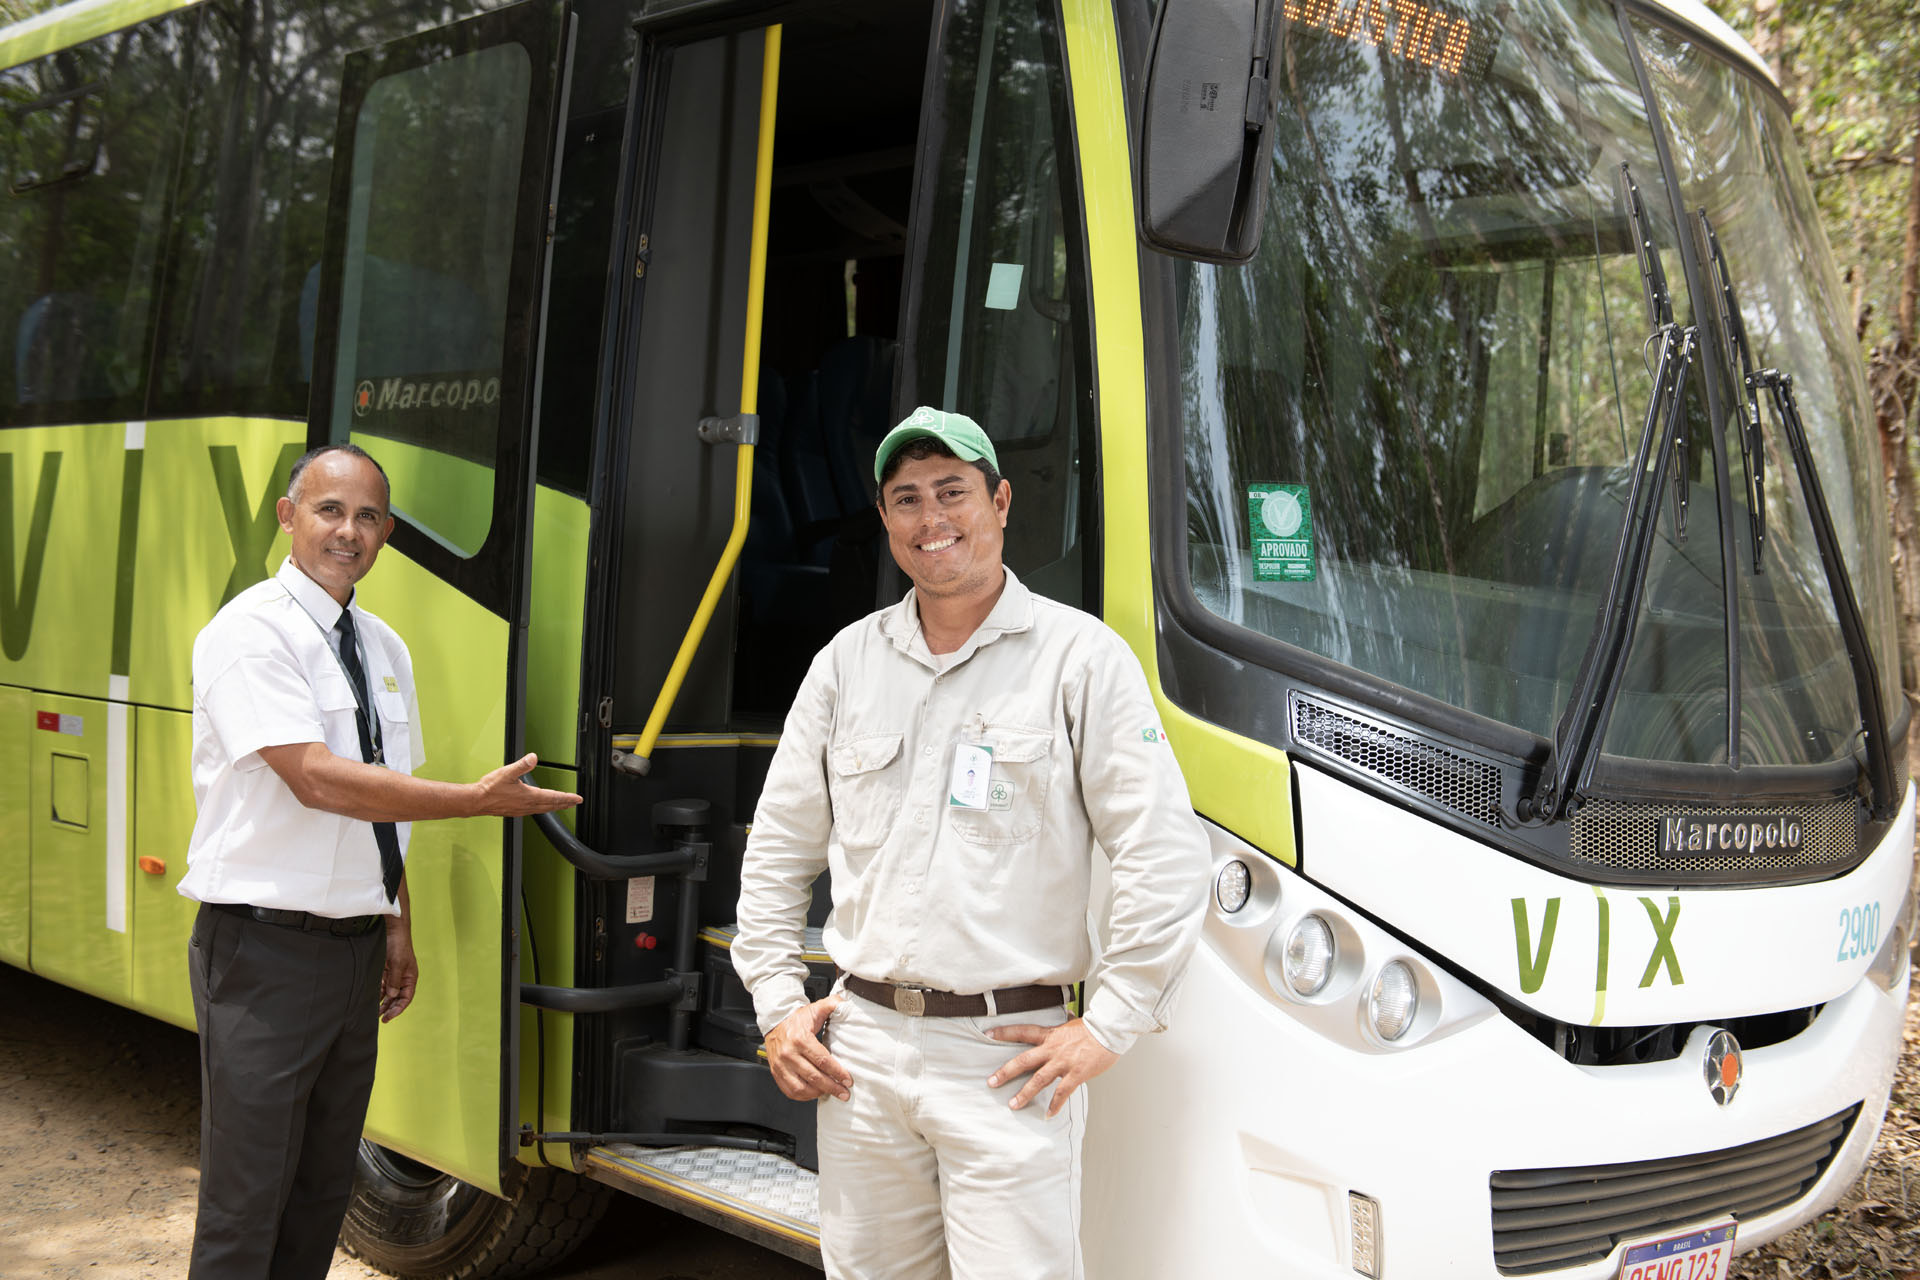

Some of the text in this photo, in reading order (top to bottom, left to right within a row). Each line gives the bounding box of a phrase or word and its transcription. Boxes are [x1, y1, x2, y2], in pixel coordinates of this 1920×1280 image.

[1261, 543, 1308, 557] APROVADO
[1665, 817, 1800, 853] Marcopolo
[1511, 895, 1684, 994] VIX
[1837, 901, 1880, 962] 2900
[1672, 1240, 1691, 1251] BRASIL
